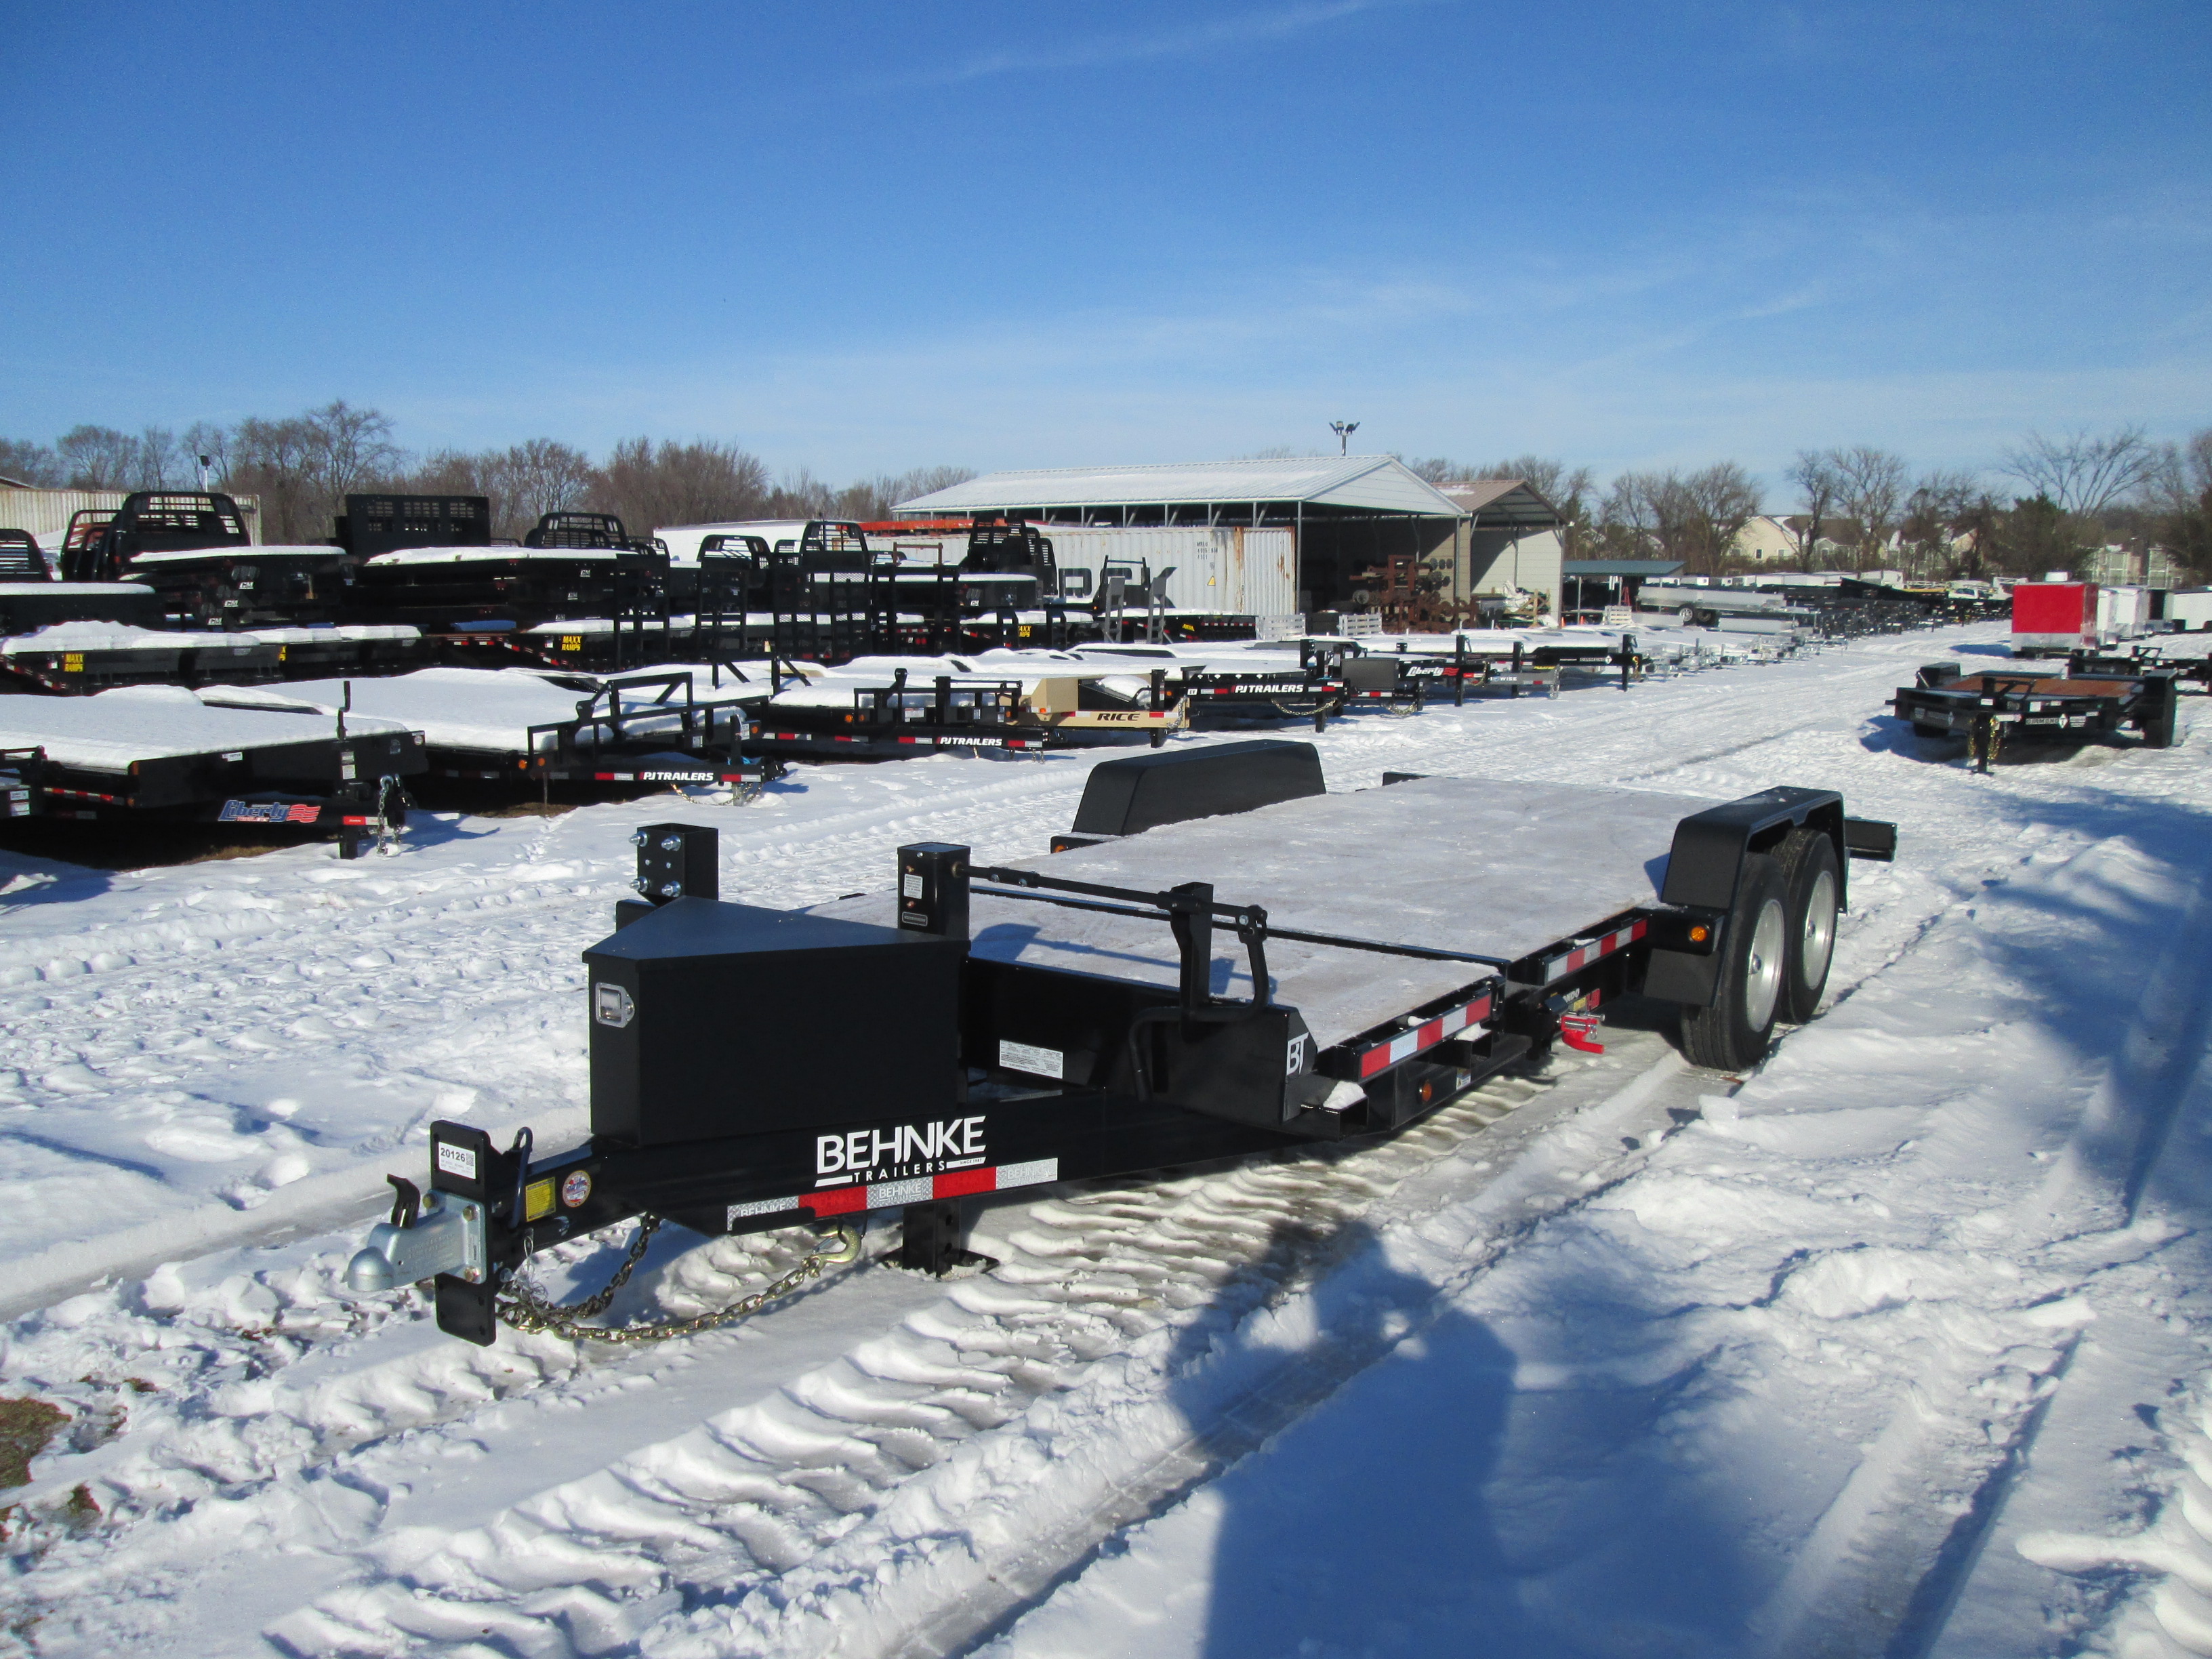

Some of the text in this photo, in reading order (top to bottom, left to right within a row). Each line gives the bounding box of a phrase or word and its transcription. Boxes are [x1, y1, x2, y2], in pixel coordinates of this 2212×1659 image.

[1406, 666, 1444, 676] Liberty
[1235, 684, 1304, 693] PJ TRAILERS
[1097, 713, 1140, 721] RICE
[940, 737, 1003, 745] PJ TRAILERS
[643, 771, 714, 781] PJ TRAILERS
[218, 800, 291, 823] Liberty
[817, 1115, 987, 1174] BEHNKE
[441, 1147, 466, 1162] 20126
[855, 1160, 944, 1183] TRAILERS
[880, 1184, 922, 1198] BEHNKE
